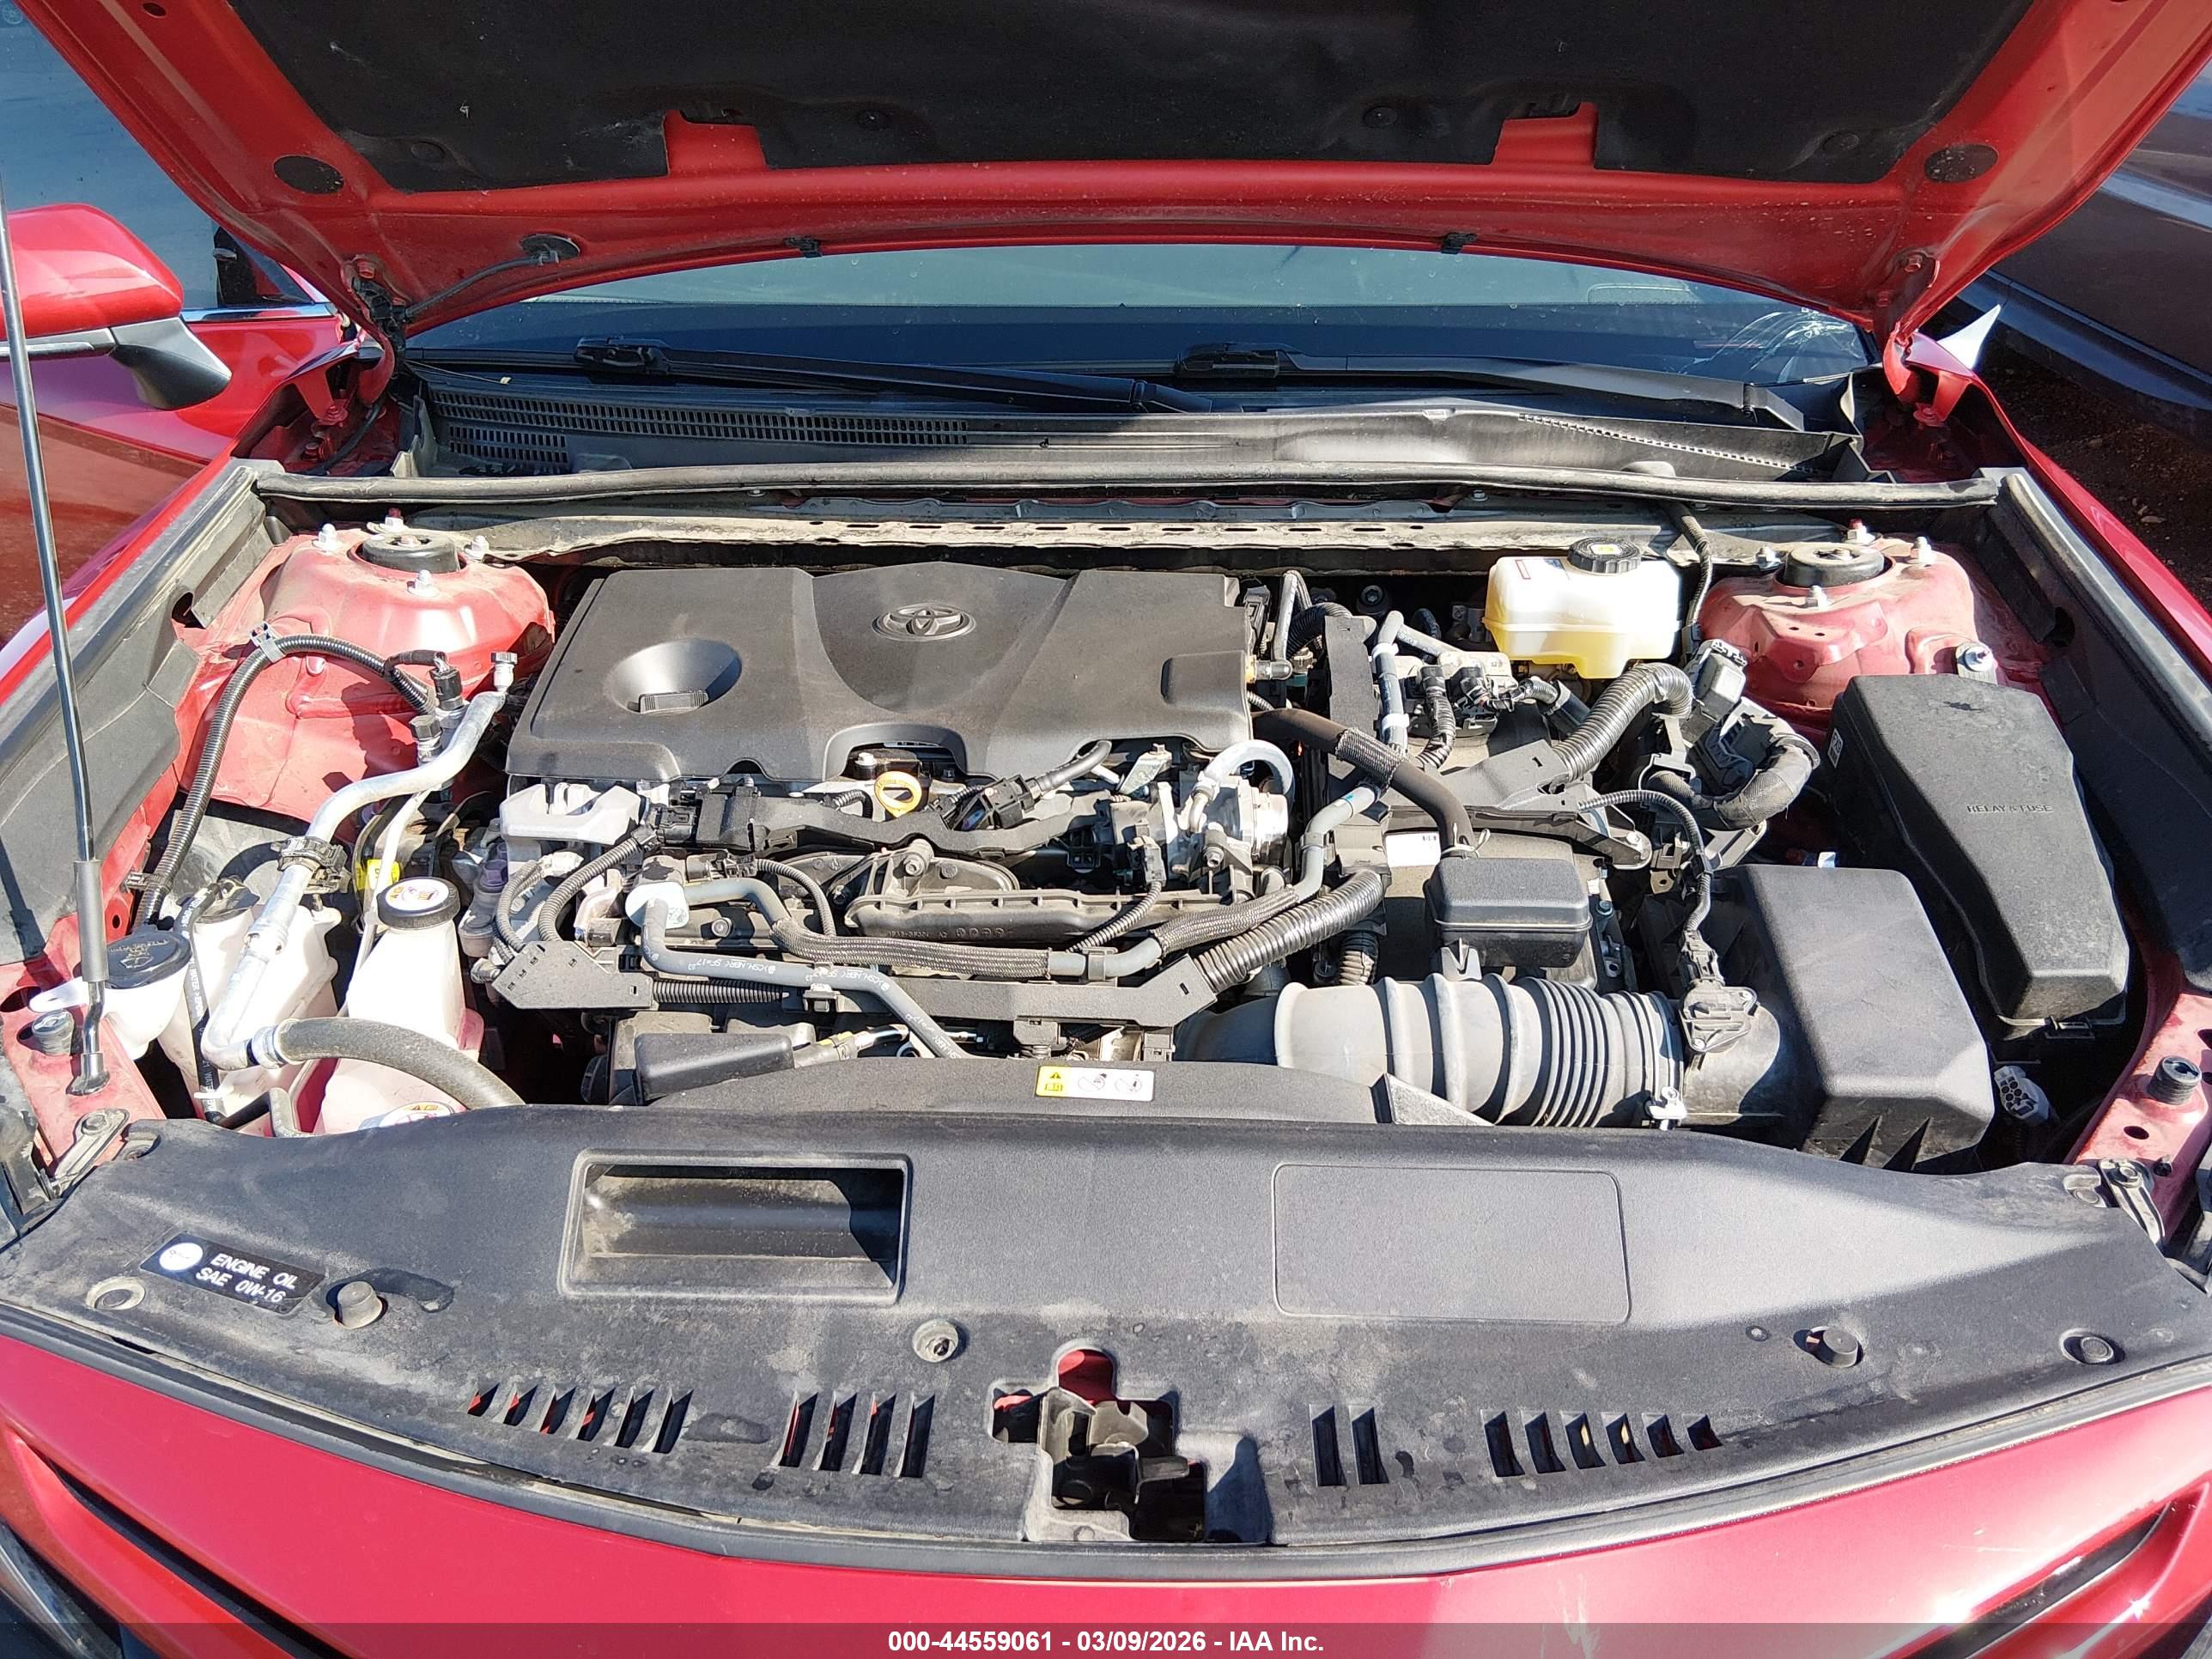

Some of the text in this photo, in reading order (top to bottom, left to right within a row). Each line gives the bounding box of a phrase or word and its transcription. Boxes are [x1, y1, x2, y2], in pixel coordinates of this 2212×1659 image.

[1966, 805, 2006, 813] RELAY
[2020, 805, 2054, 813] FUSE
[196, 1267, 287, 1303] SAE 0W-16
[210, 1253, 300, 1290] ENGINE OIL
